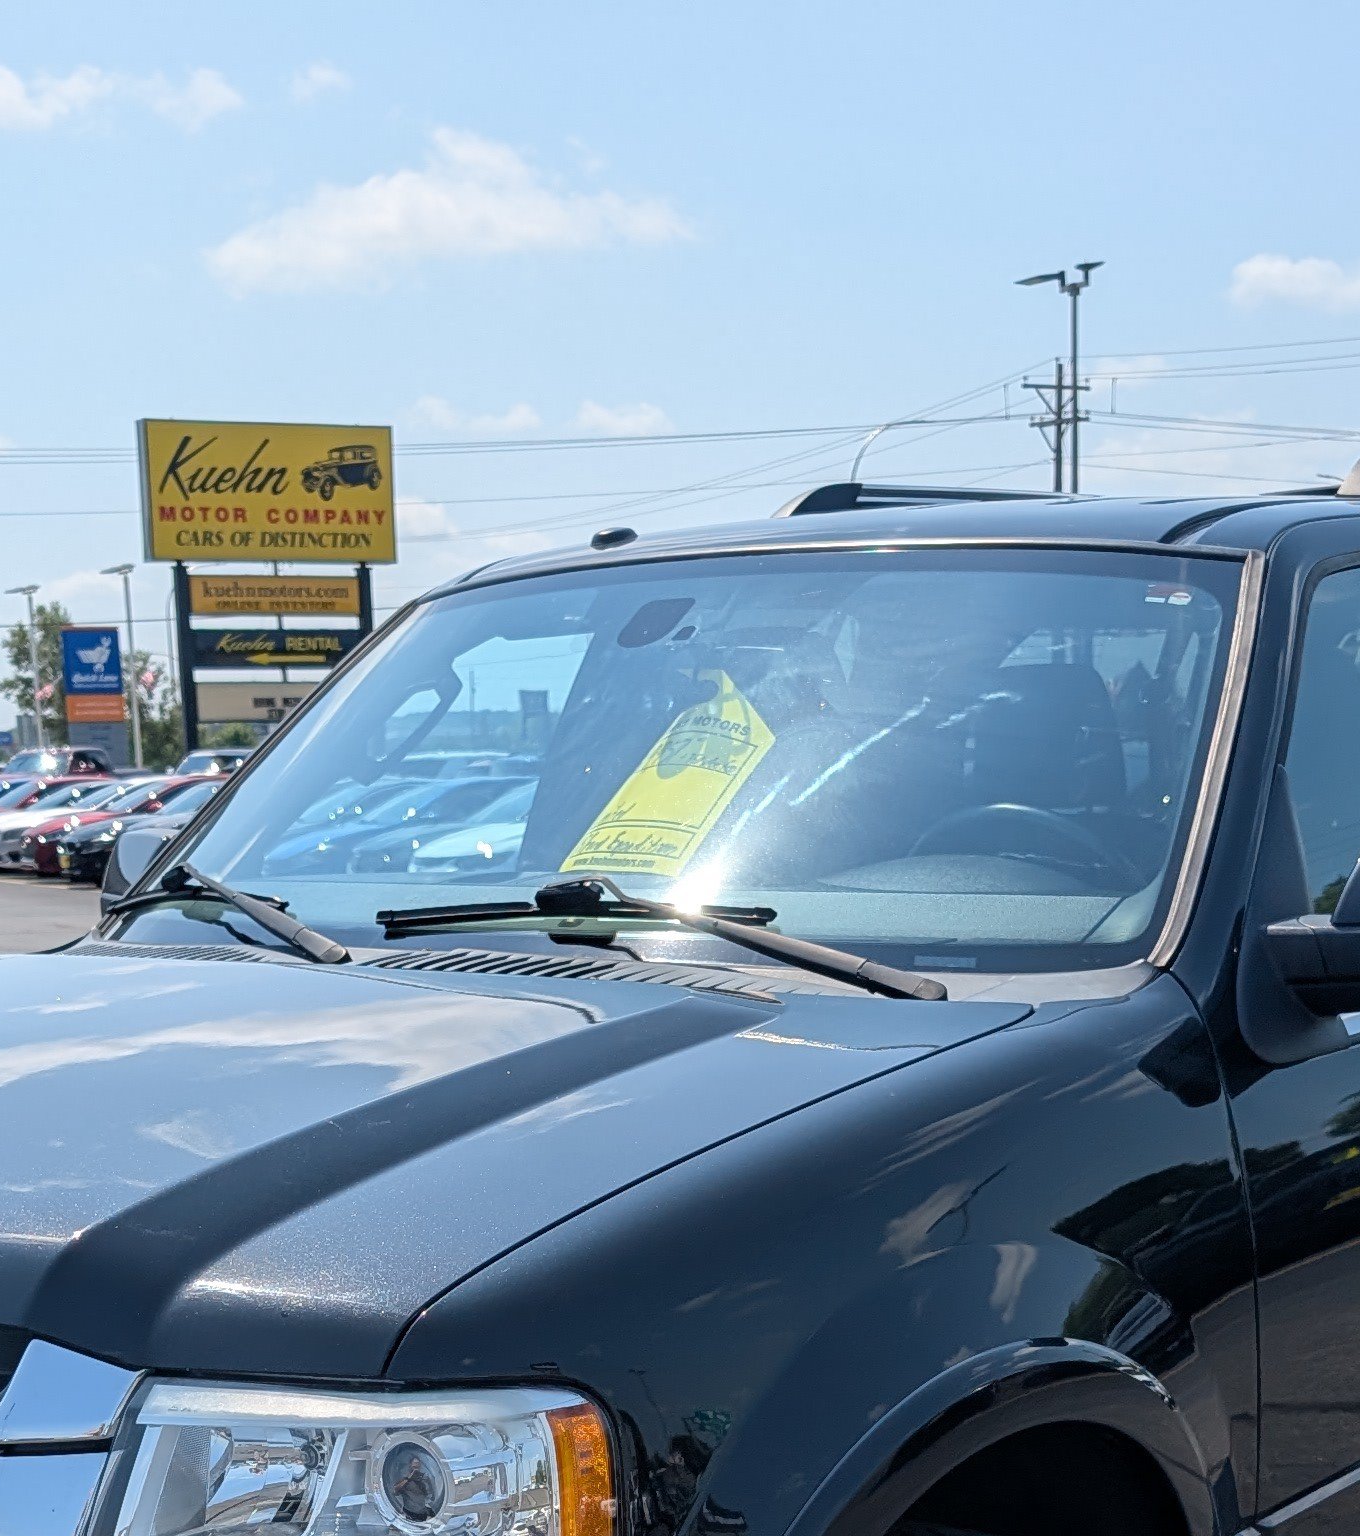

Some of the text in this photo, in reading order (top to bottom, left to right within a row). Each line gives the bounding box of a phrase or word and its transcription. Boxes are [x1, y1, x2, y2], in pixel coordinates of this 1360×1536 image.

[158, 436, 289, 501] Kuehn
[159, 505, 386, 526] MOTOR COMPANY
[175, 529, 372, 548] CARS OF DISTINCTION
[202, 581, 349, 598] kuehnmotors.com
[285, 636, 342, 651] RENTAL
[695, 716, 751, 736] MOTORS
